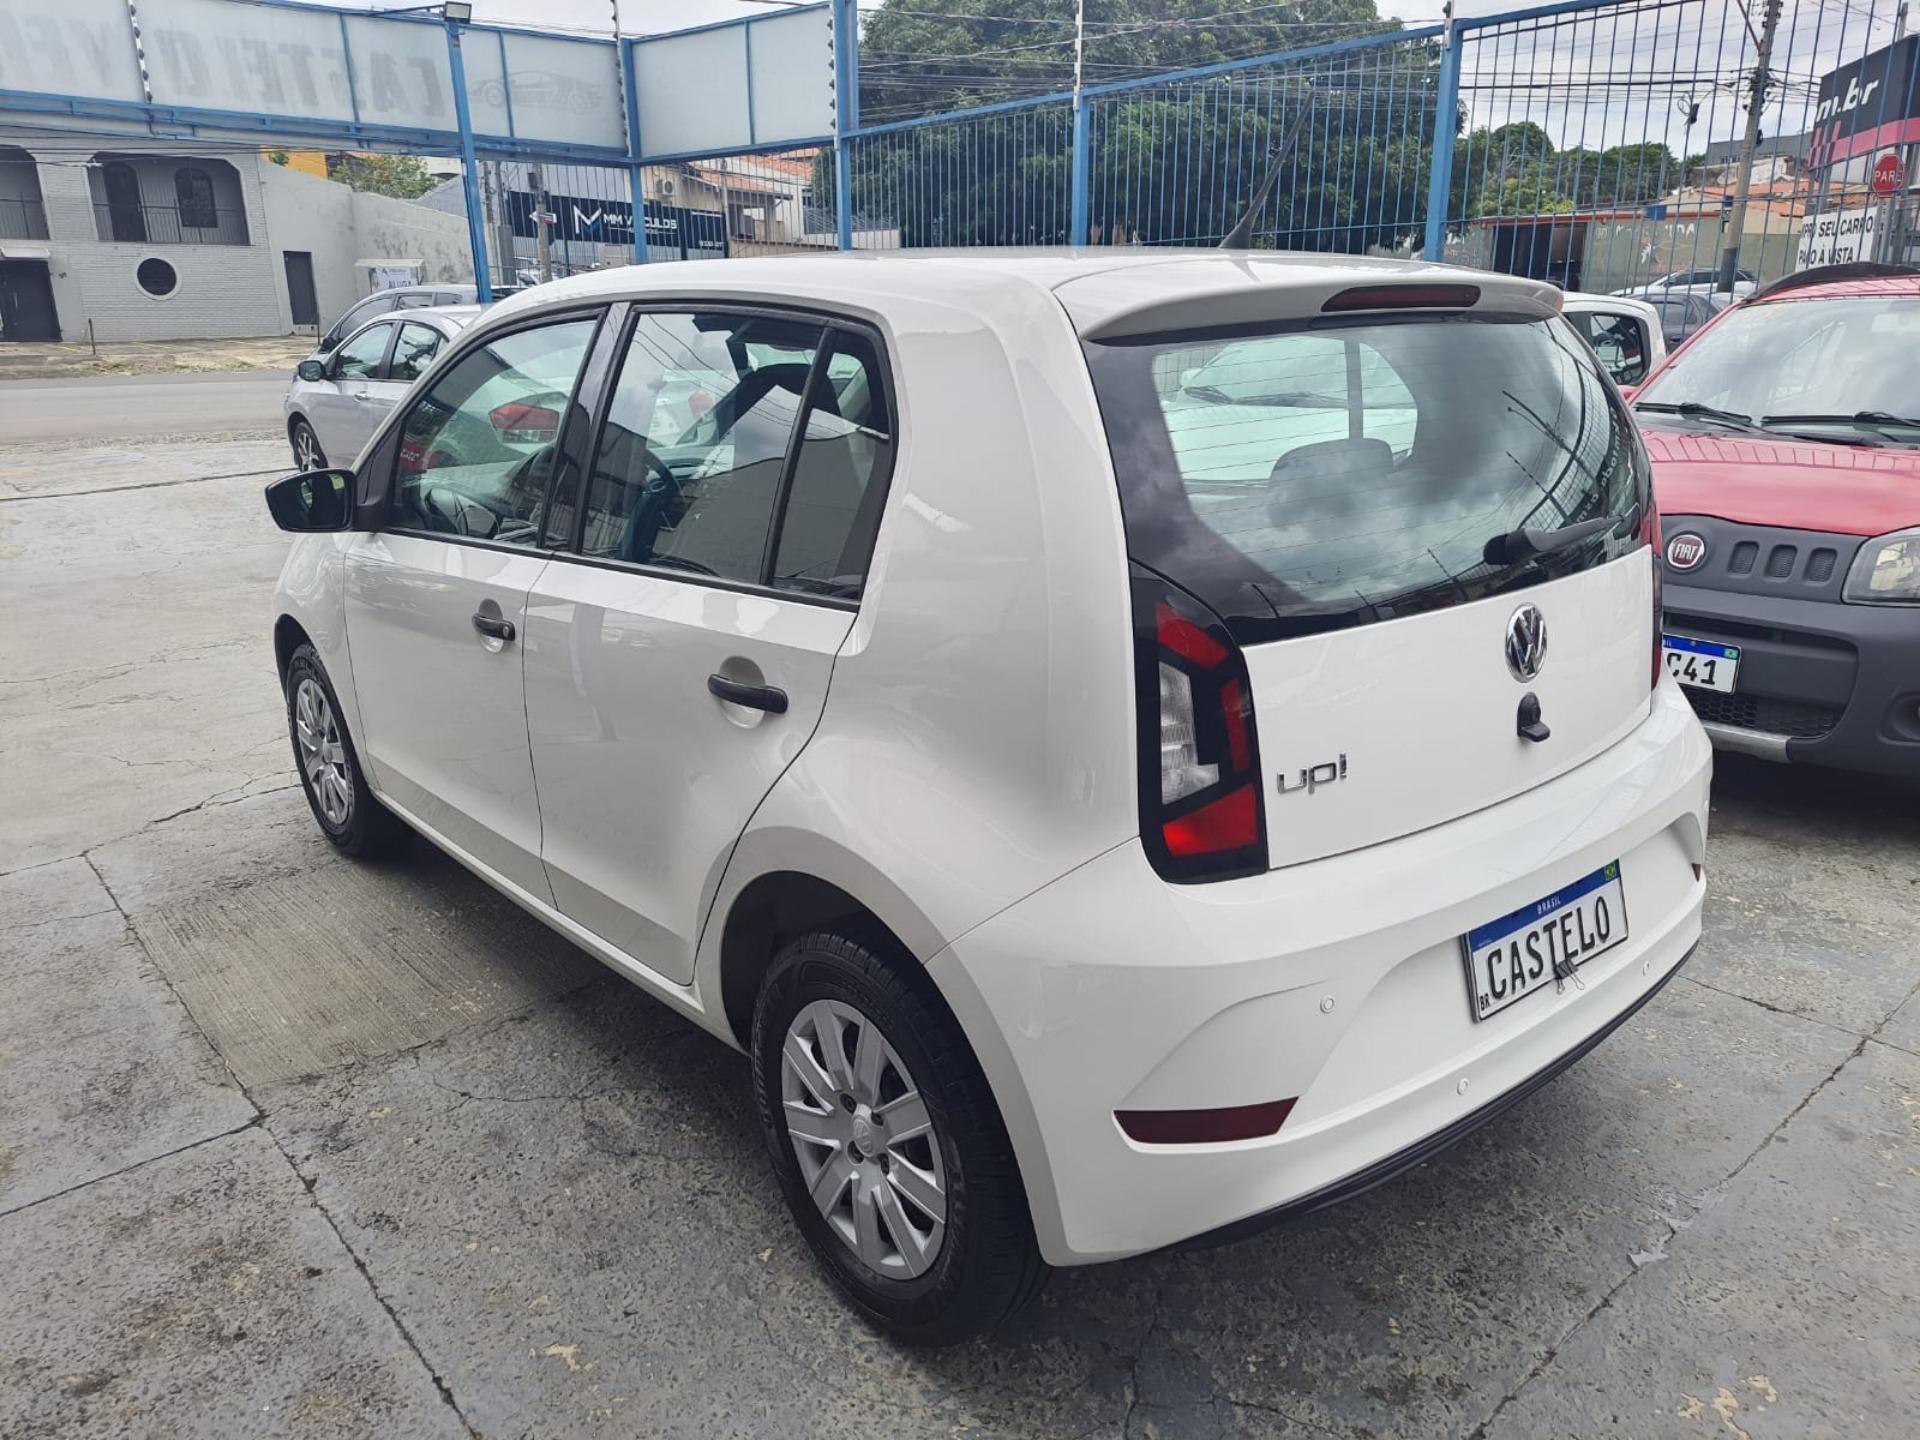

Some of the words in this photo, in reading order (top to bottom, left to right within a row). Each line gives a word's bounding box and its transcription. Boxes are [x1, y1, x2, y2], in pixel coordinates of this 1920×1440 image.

[1873, 169, 1903, 184] PARE
[624, 215, 677, 229] VCULOS
[1674, 543, 1698, 560] FIAT
[1666, 652, 1718, 685] C41
[1276, 751, 1348, 794] up!
[1536, 895, 1561, 915] BRASIL
[1487, 895, 1610, 1000] CASTELO
[1479, 993, 1491, 1011] BR
